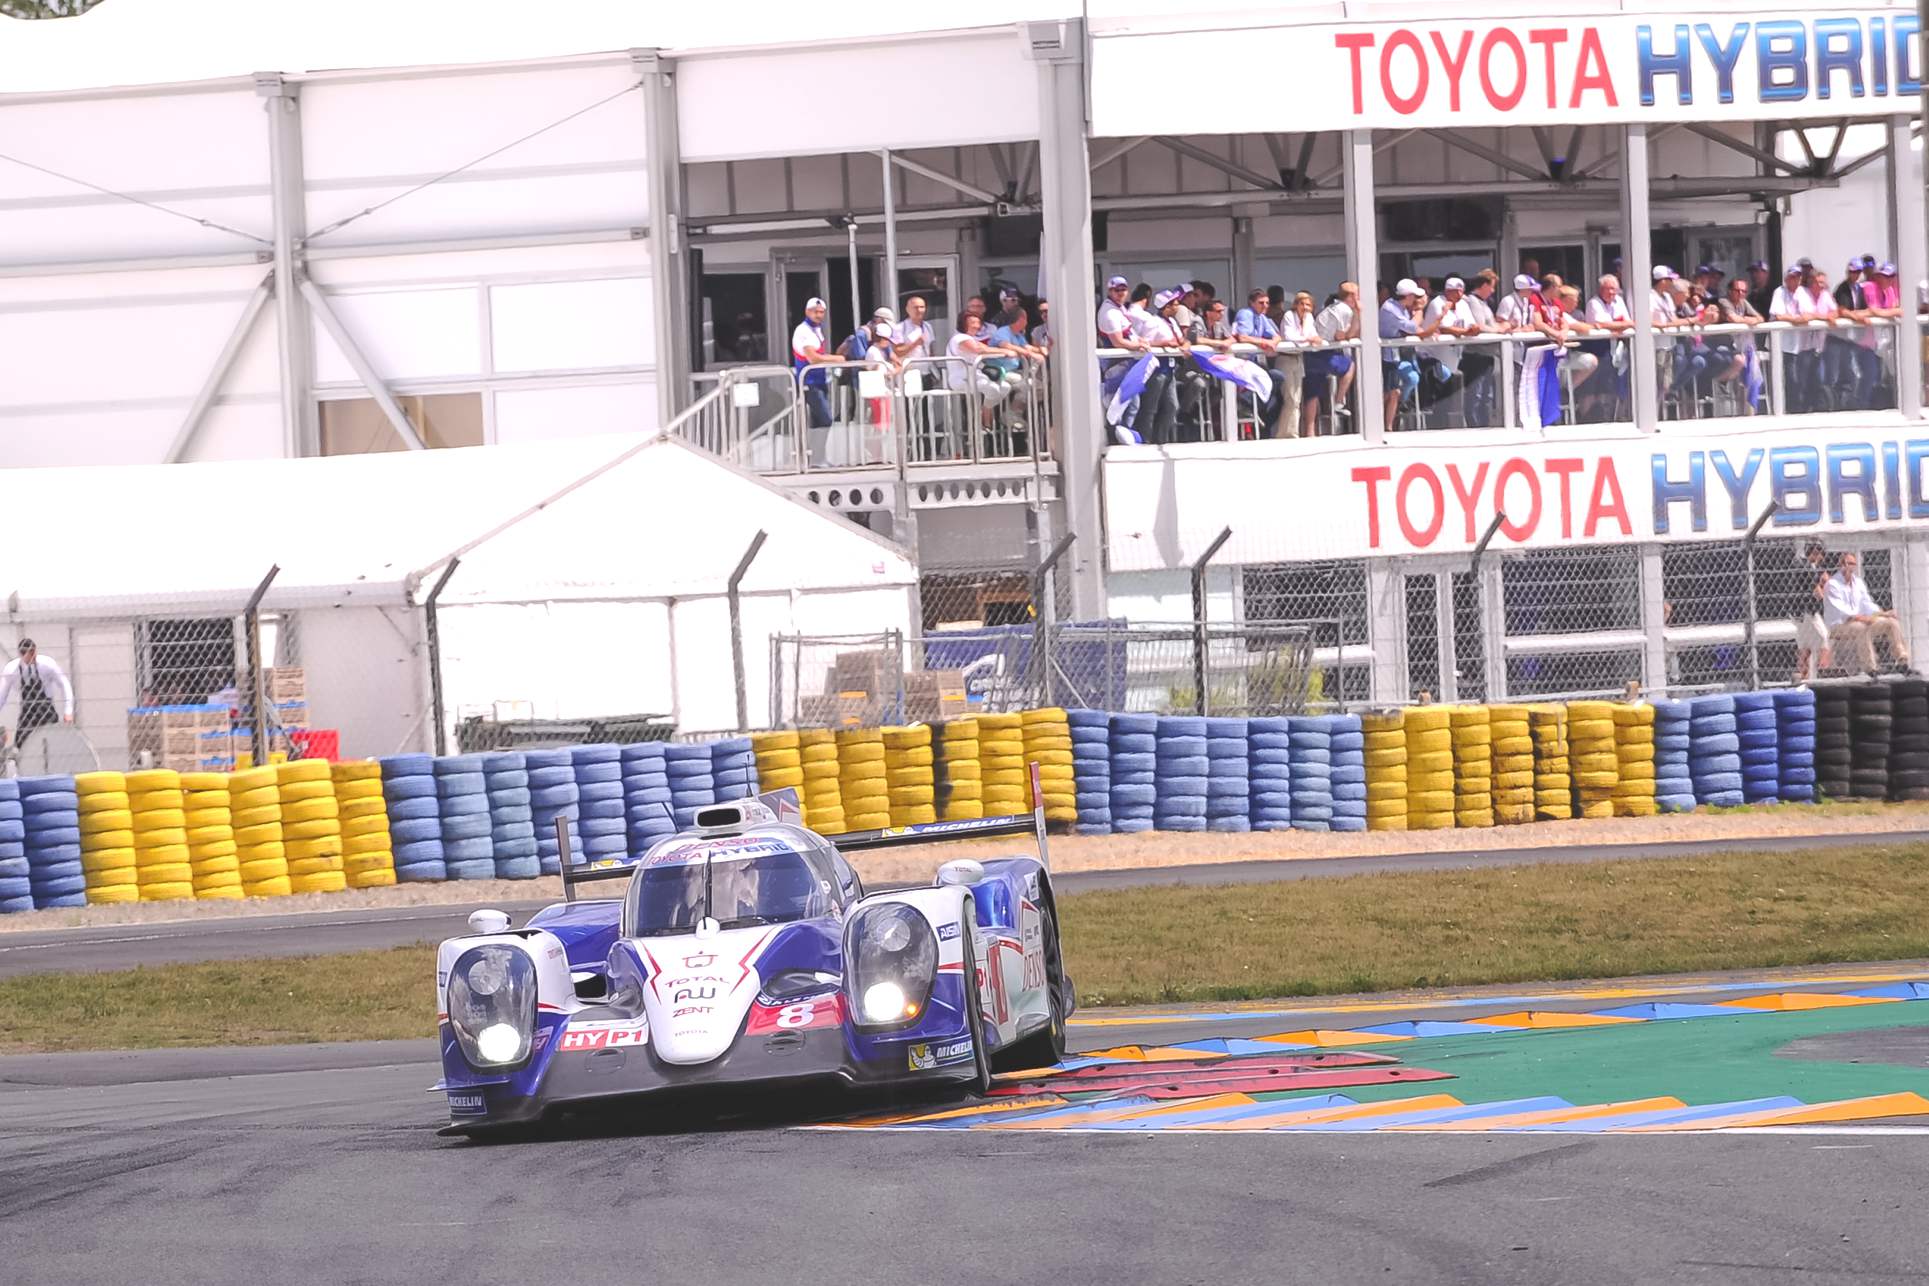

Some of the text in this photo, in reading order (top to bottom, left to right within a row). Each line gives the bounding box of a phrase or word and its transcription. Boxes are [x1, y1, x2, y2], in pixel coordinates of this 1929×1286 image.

[1335, 27, 1619, 115] TOYOTA
[1351, 457, 1633, 548] TOYOTA
[922, 817, 1011, 832] MICHELIN
[649, 852, 703, 865] OYOTA
[710, 843, 790, 858] HYBRID
[665, 976, 730, 988] TOTAL
[673, 1006, 715, 1018] ZENT
[776, 1003, 814, 1028] 8
[936, 1040, 973, 1058] MICHELI
